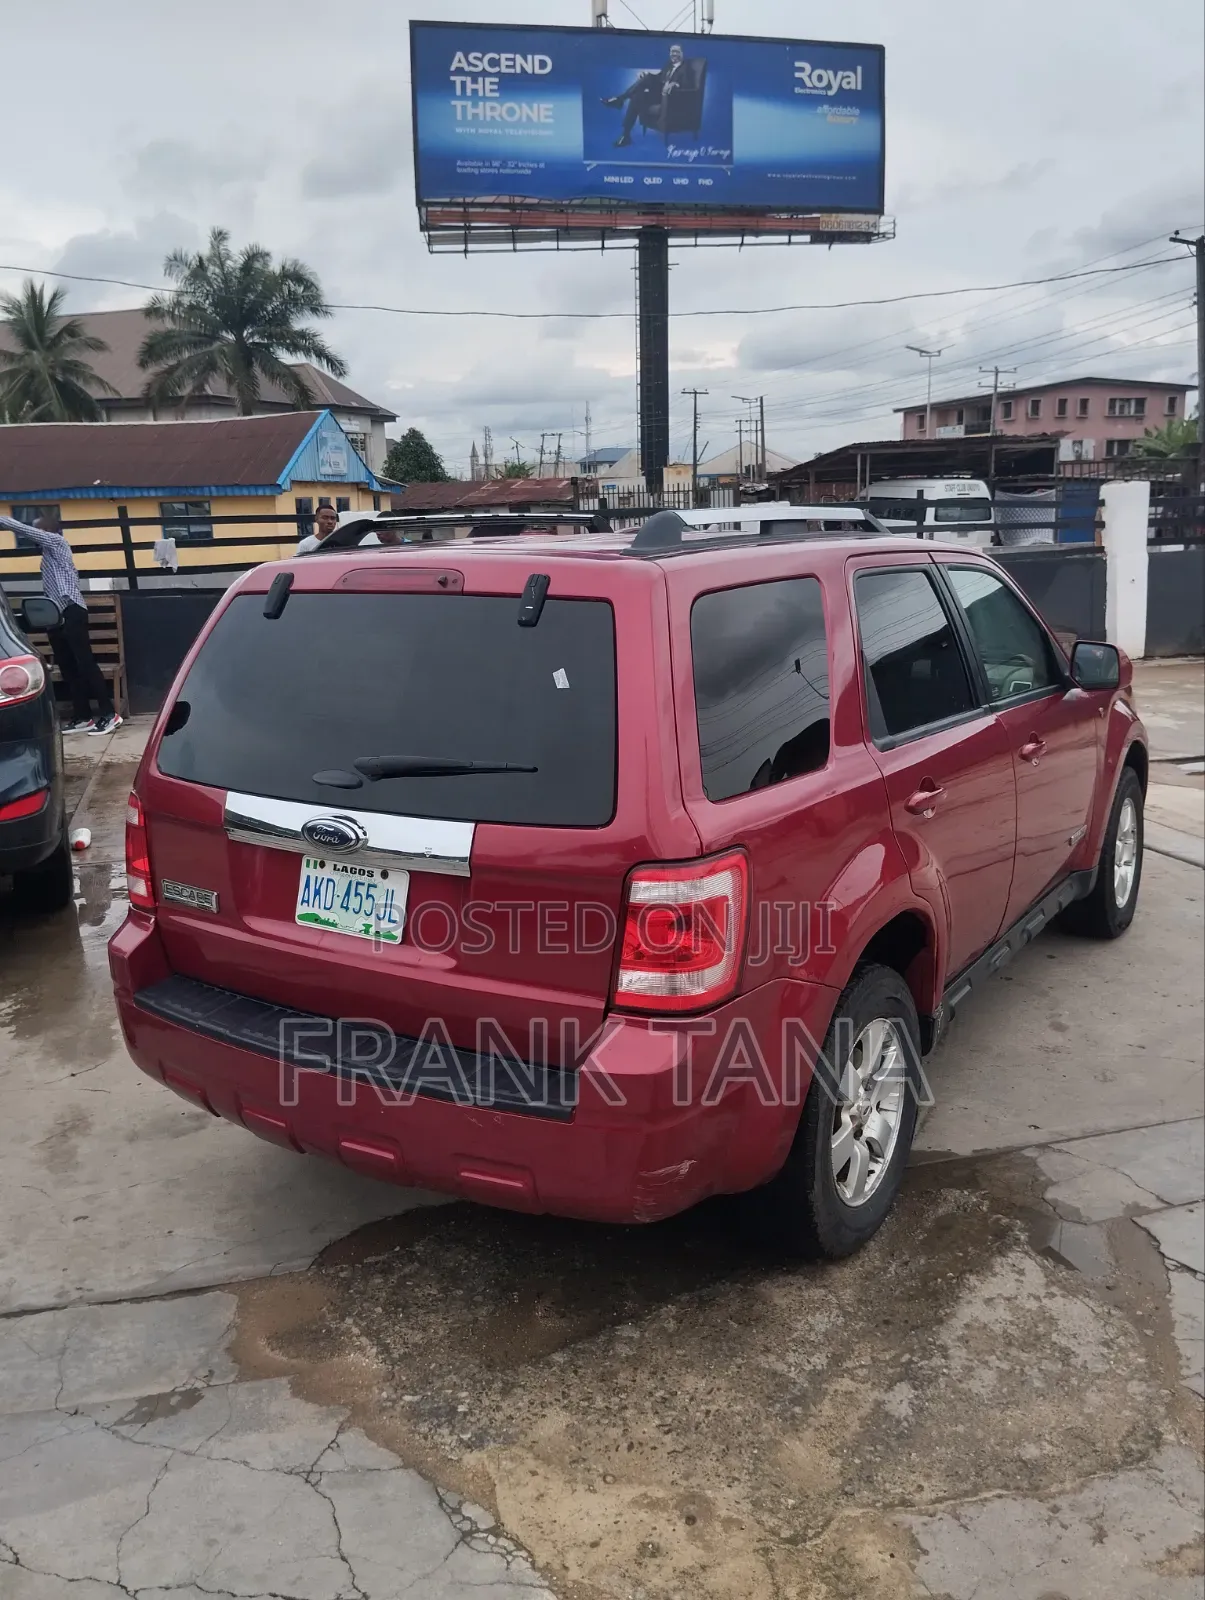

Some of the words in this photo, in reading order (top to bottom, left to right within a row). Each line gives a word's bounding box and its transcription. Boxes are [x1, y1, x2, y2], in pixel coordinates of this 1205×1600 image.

[450, 51, 553, 75] ASCEND
[450, 76, 500, 98] THE
[794, 61, 862, 96] Royal
[794, 87, 826, 96] Electronics
[451, 100, 555, 123] THRONE
[817, 104, 861, 116] affordable
[620, 176, 634, 184] LED
[643, 177, 663, 186] QLED
[673, 177, 689, 186] UHD
[698, 178, 714, 187] FHD
[311, 823, 342, 845] Ford
[333, 863, 375, 878] LAGOS
[163, 883, 212, 905] ESCAPE
